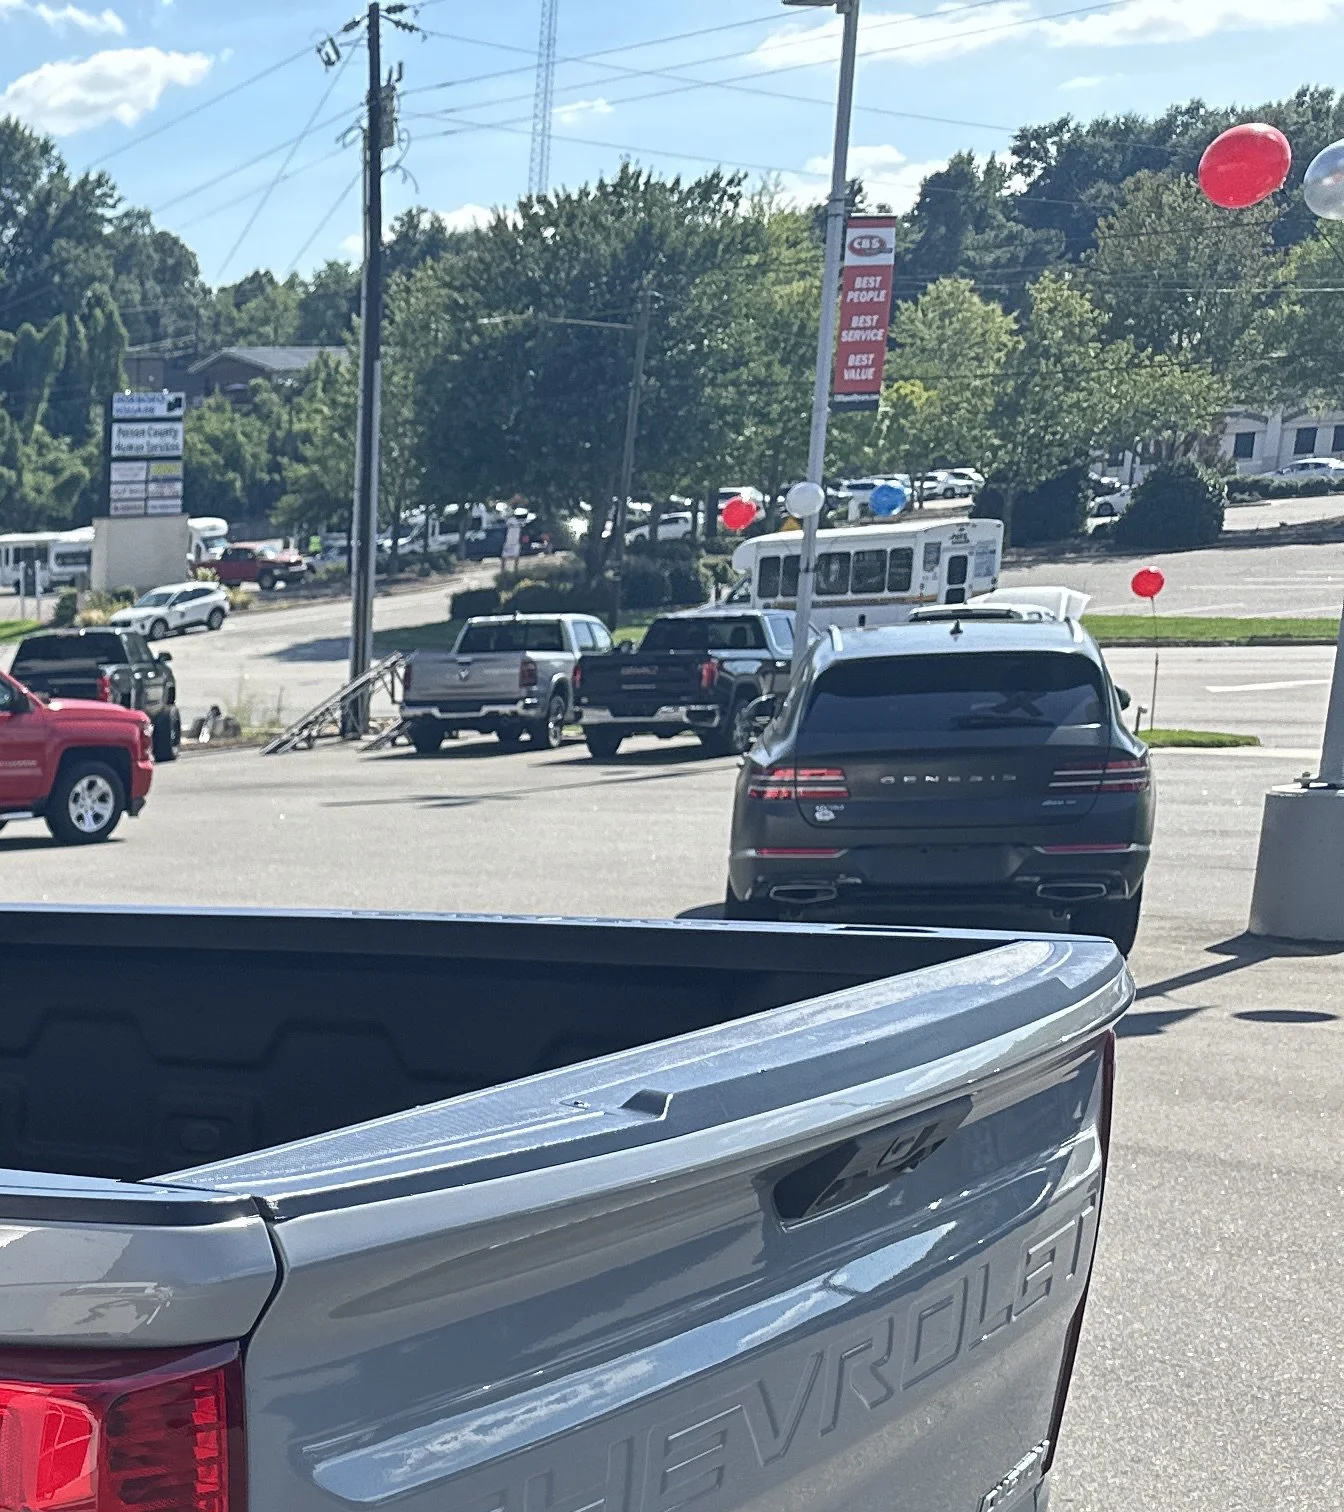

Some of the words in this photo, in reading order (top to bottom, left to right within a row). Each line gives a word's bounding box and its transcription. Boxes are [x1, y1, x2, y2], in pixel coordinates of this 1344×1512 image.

[853, 237, 881, 249] CBS
[854, 276, 882, 289] BEST
[846, 290, 887, 302] PEOPLE
[851, 315, 879, 328] BEST
[841, 329, 885, 342] SERVICE
[848, 354, 875, 366] BEST
[844, 367, 875, 380] VALUE
[880, 774, 1016, 784] GENESIS
